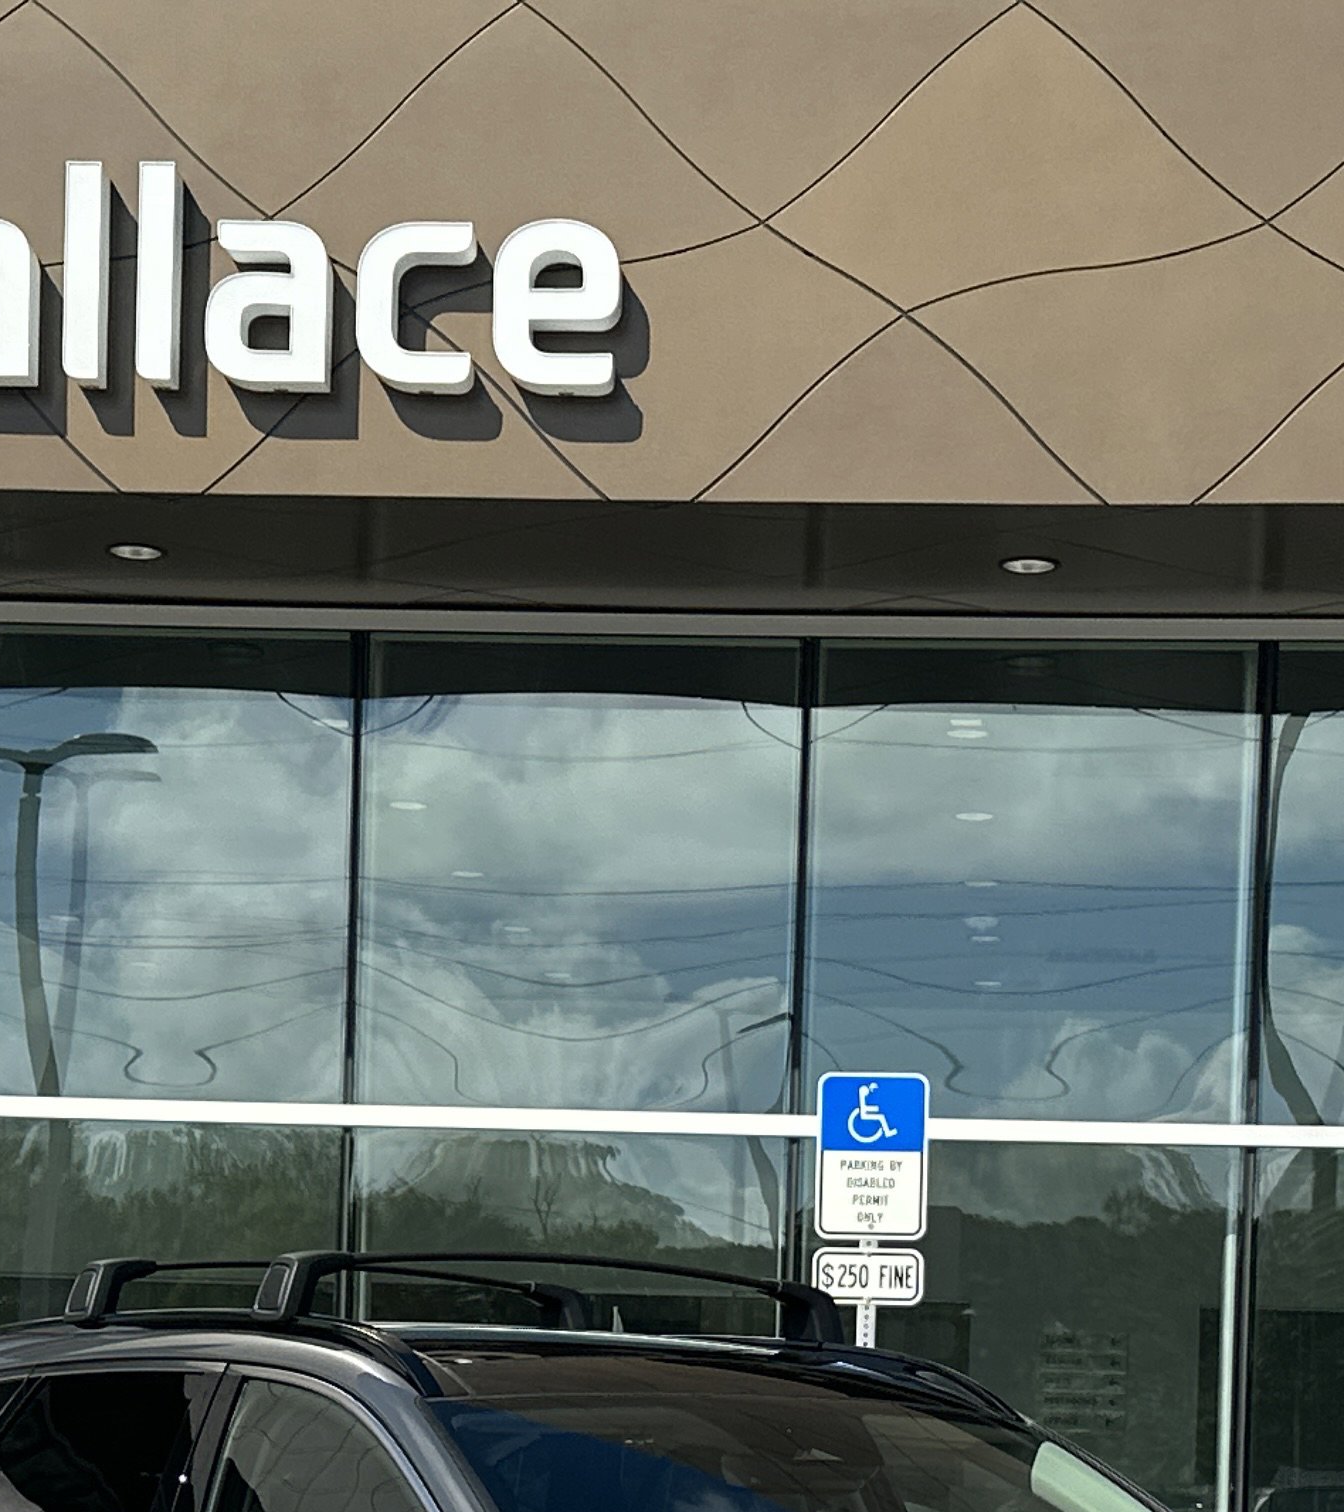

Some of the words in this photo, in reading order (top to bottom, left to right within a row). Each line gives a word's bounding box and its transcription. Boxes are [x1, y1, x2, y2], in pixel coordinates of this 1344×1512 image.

[840, 1159, 884, 1171] PARKING
[889, 1160, 903, 1172] BY
[847, 1177, 896, 1189] DISABLED
[852, 1194, 889, 1206] PERMIT
[857, 1211, 884, 1223] ONLY
[821, 1263, 869, 1290] $250
[879, 1264, 914, 1290] FINE
